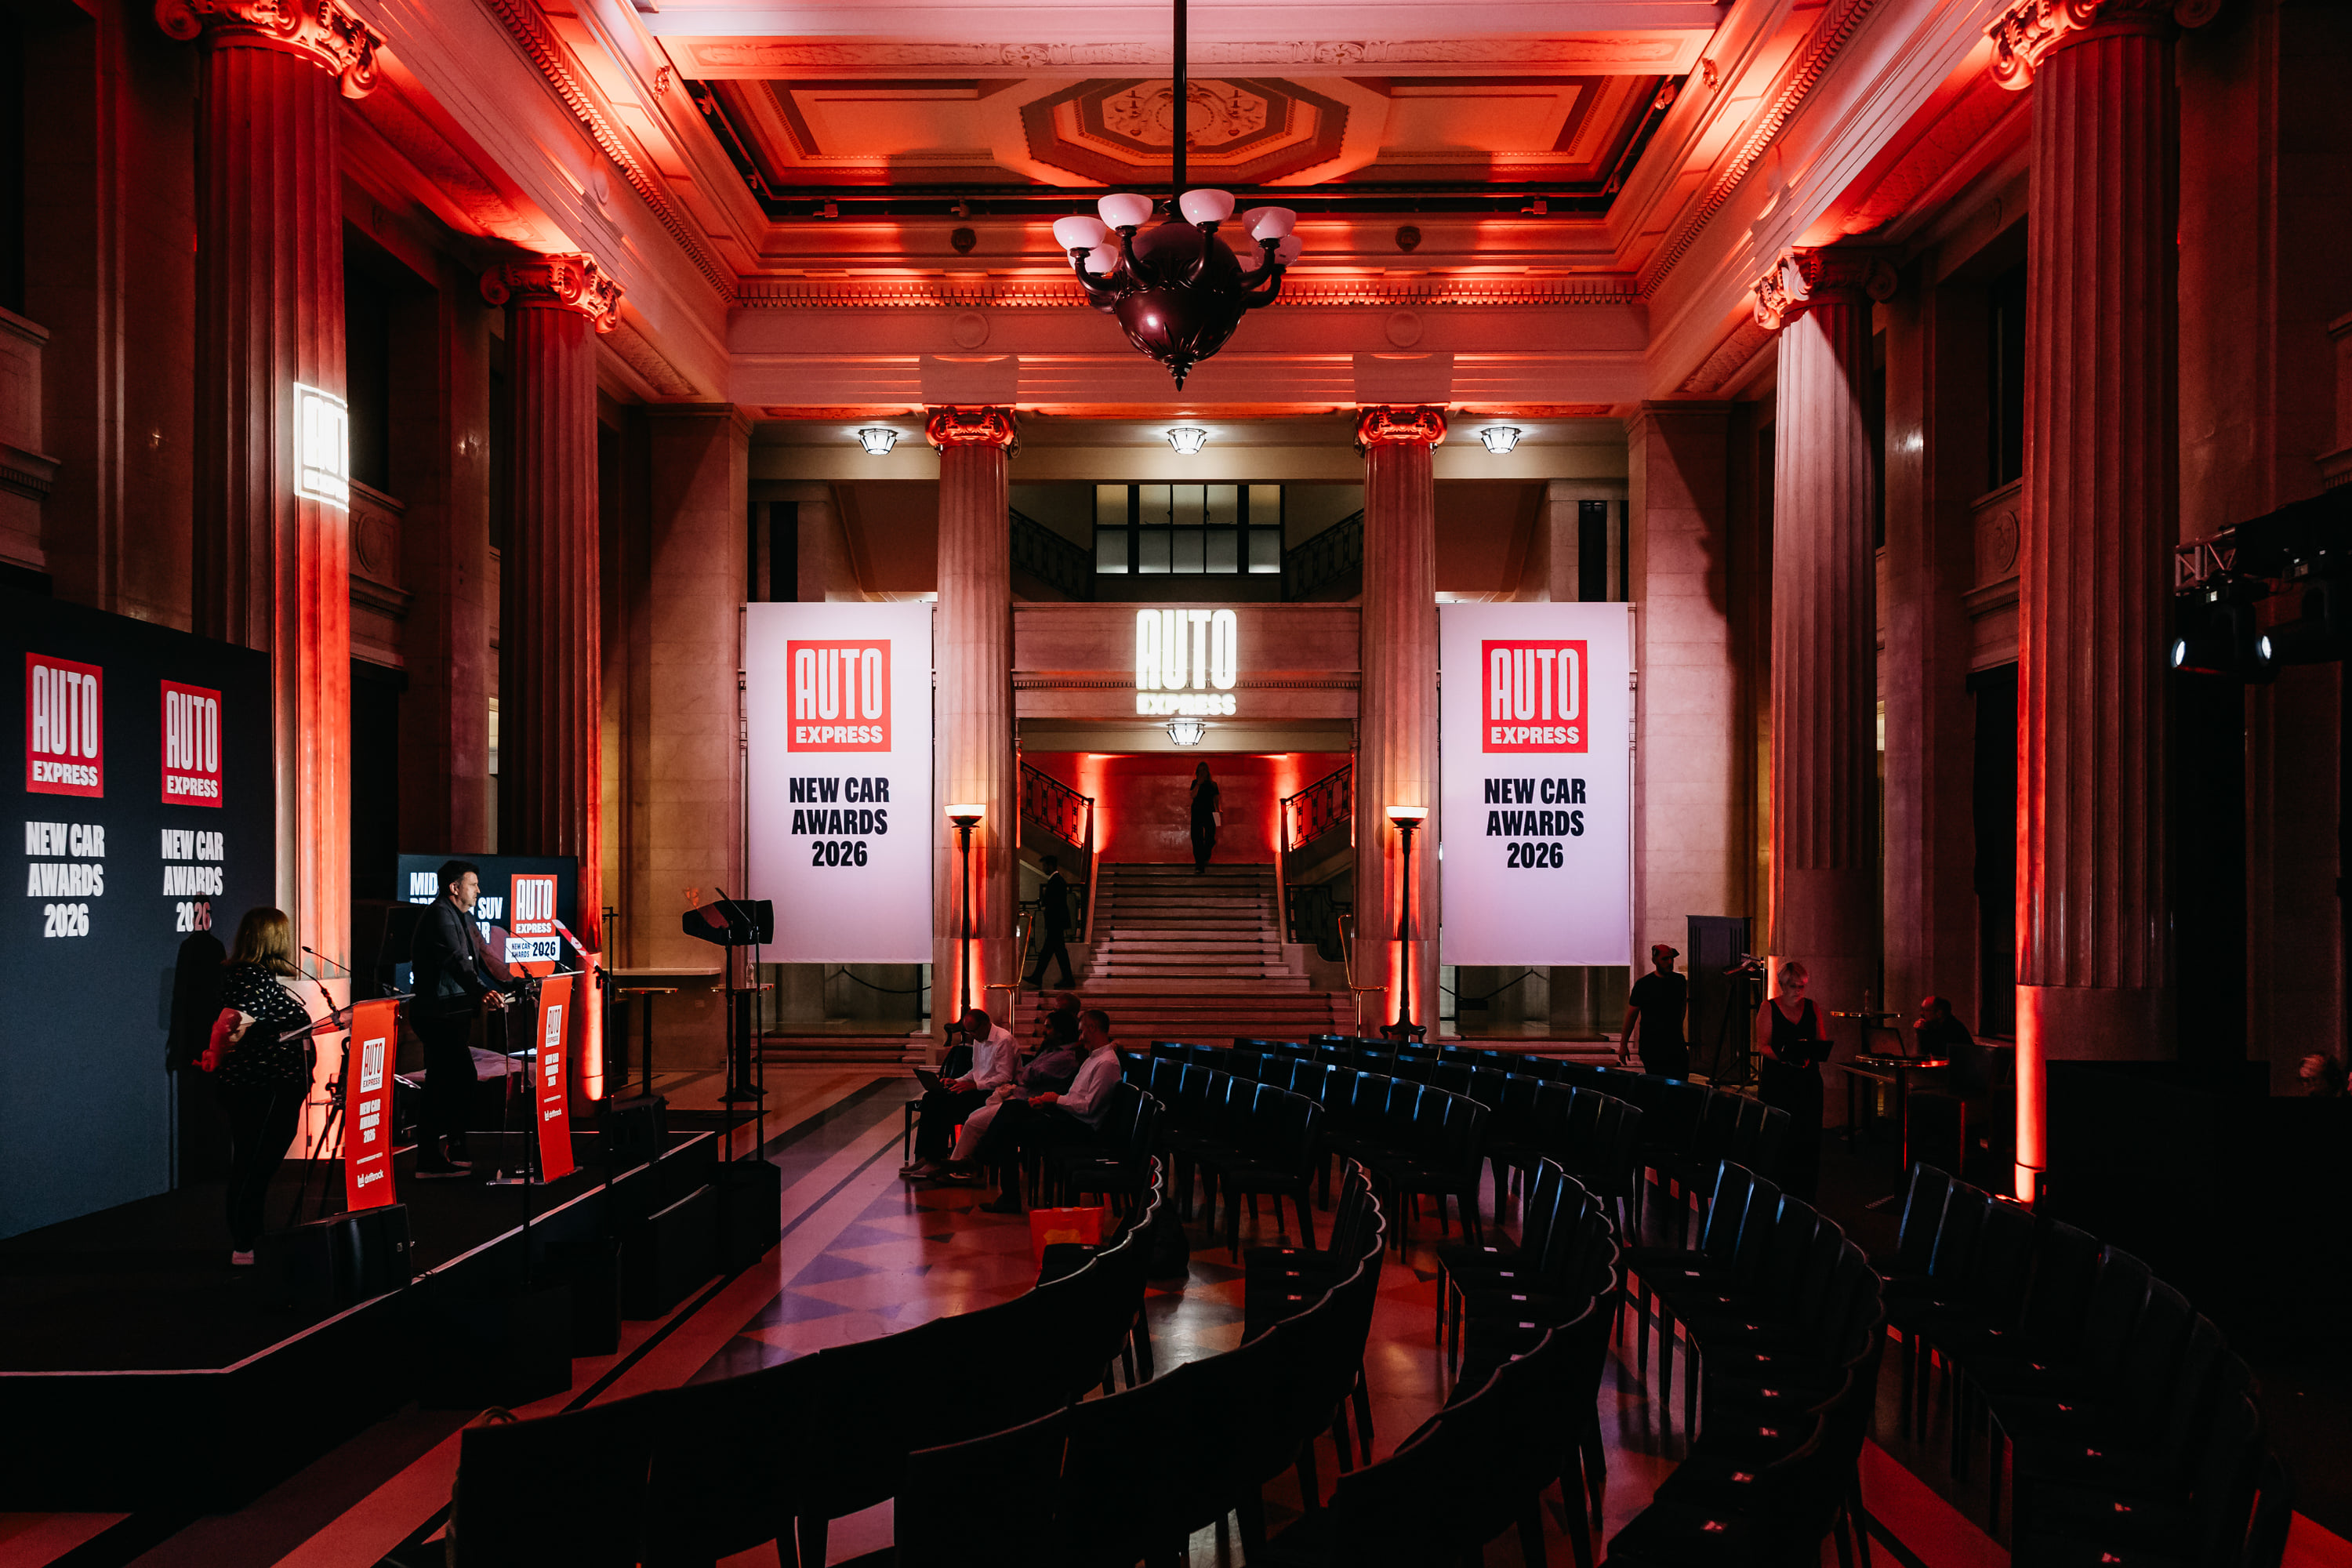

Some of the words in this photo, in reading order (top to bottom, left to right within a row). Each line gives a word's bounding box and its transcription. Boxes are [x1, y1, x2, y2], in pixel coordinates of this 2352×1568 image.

[1136, 608, 1237, 691] AUTO
[795, 648, 883, 720] AUTO
[1490, 648, 1579, 720] AUTO
[32, 665, 97, 759] AUTO
[1136, 691, 1237, 716] EXPRESS
[165, 690, 218, 773] AUTO
[796, 725, 883, 744] EXPRESS
[1491, 726, 1580, 745] EXPRESS
[33, 760, 98, 787] EXPRESS
[166, 775, 218, 798] EXPRESS
[789, 777, 840, 803] NEW
[844, 777, 890, 803] CAR
[1484, 779, 1535, 804] NEW
[1541, 778, 1587, 804] CAR
[791, 809, 888, 836] AWARDS
[1486, 810, 1584, 837] AWARDS
[25, 821, 68, 857] NEW
[70, 823, 105, 858] CAR
[162, 829, 194, 860] NEW
[196, 830, 223, 861] CAR
[811, 840, 868, 867] 2026
[1507, 842, 1564, 869] 2026
[27, 863, 103, 897] AWARDS
[163, 866, 223, 896] AWARDS
[410, 872, 439, 896] MID
[477, 897, 503, 920] SUV
[516, 879, 553, 920] AUTO
[44, 903, 89, 938] 2026
[176, 902, 212, 932] 2026
[516, 923, 552, 934] EXPRESS
[533, 941, 556, 956] 2026
[548, 1009, 560, 1035] AUTO
[364, 1043, 382, 1076] AUTO
[359, 1101, 371, 1116] NEW
[371, 1098, 381, 1112] CAR
